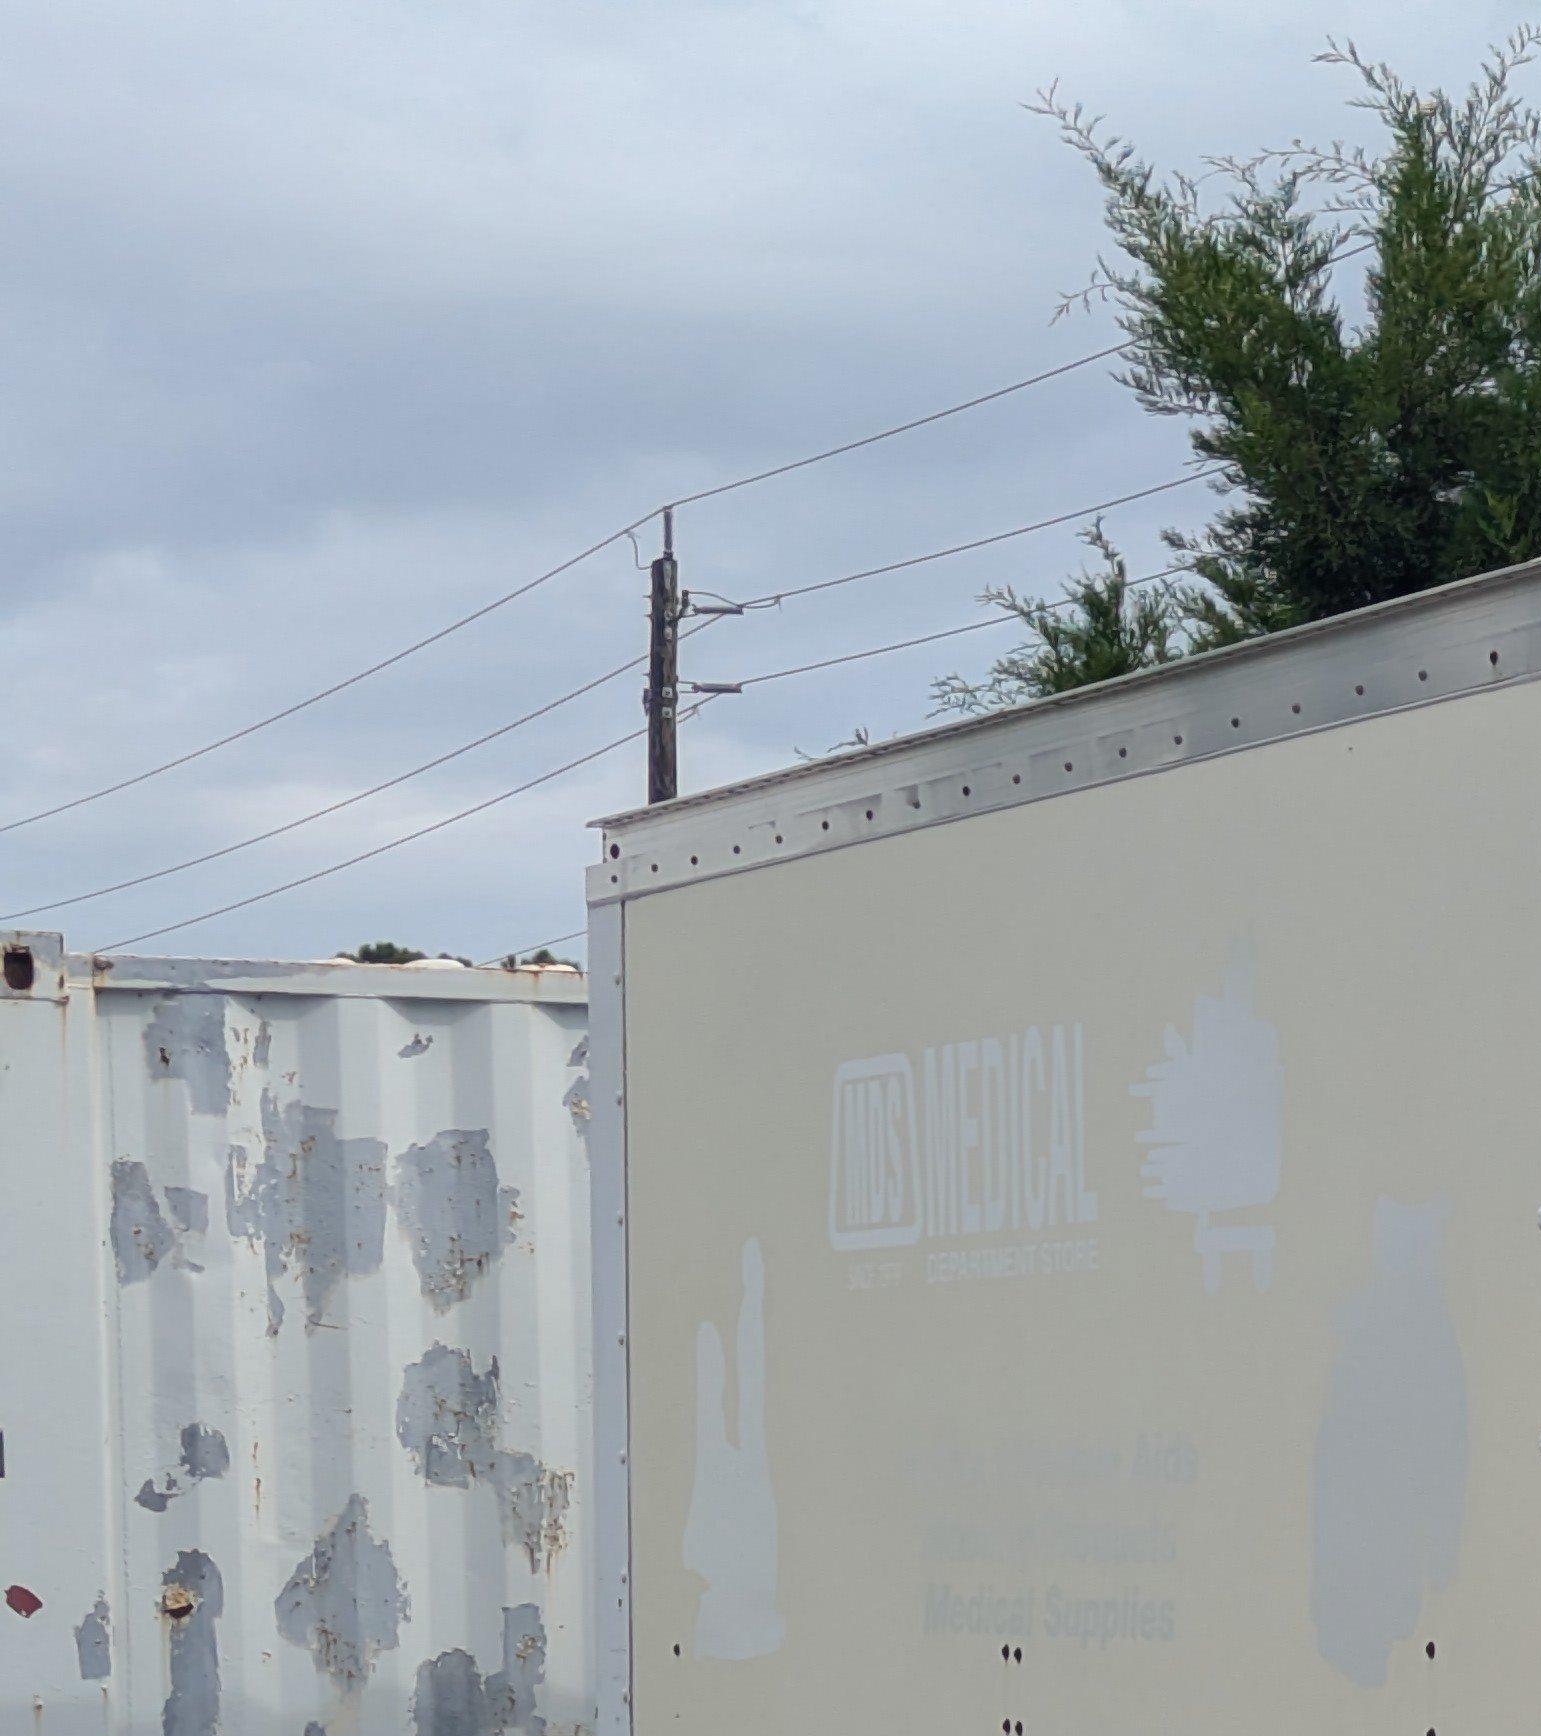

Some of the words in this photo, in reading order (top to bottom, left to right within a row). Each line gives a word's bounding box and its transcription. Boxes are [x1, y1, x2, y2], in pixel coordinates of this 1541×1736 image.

[844, 1076, 904, 1225] MDS
[923, 1022, 1097, 1237] MEDICAL
[927, 1245, 1037, 1284] DEPARTMENT
[1041, 1239, 1100, 1274] STORE
[922, 1583, 1034, 1636] Medical
[1043, 1585, 1176, 1650] Supplies
